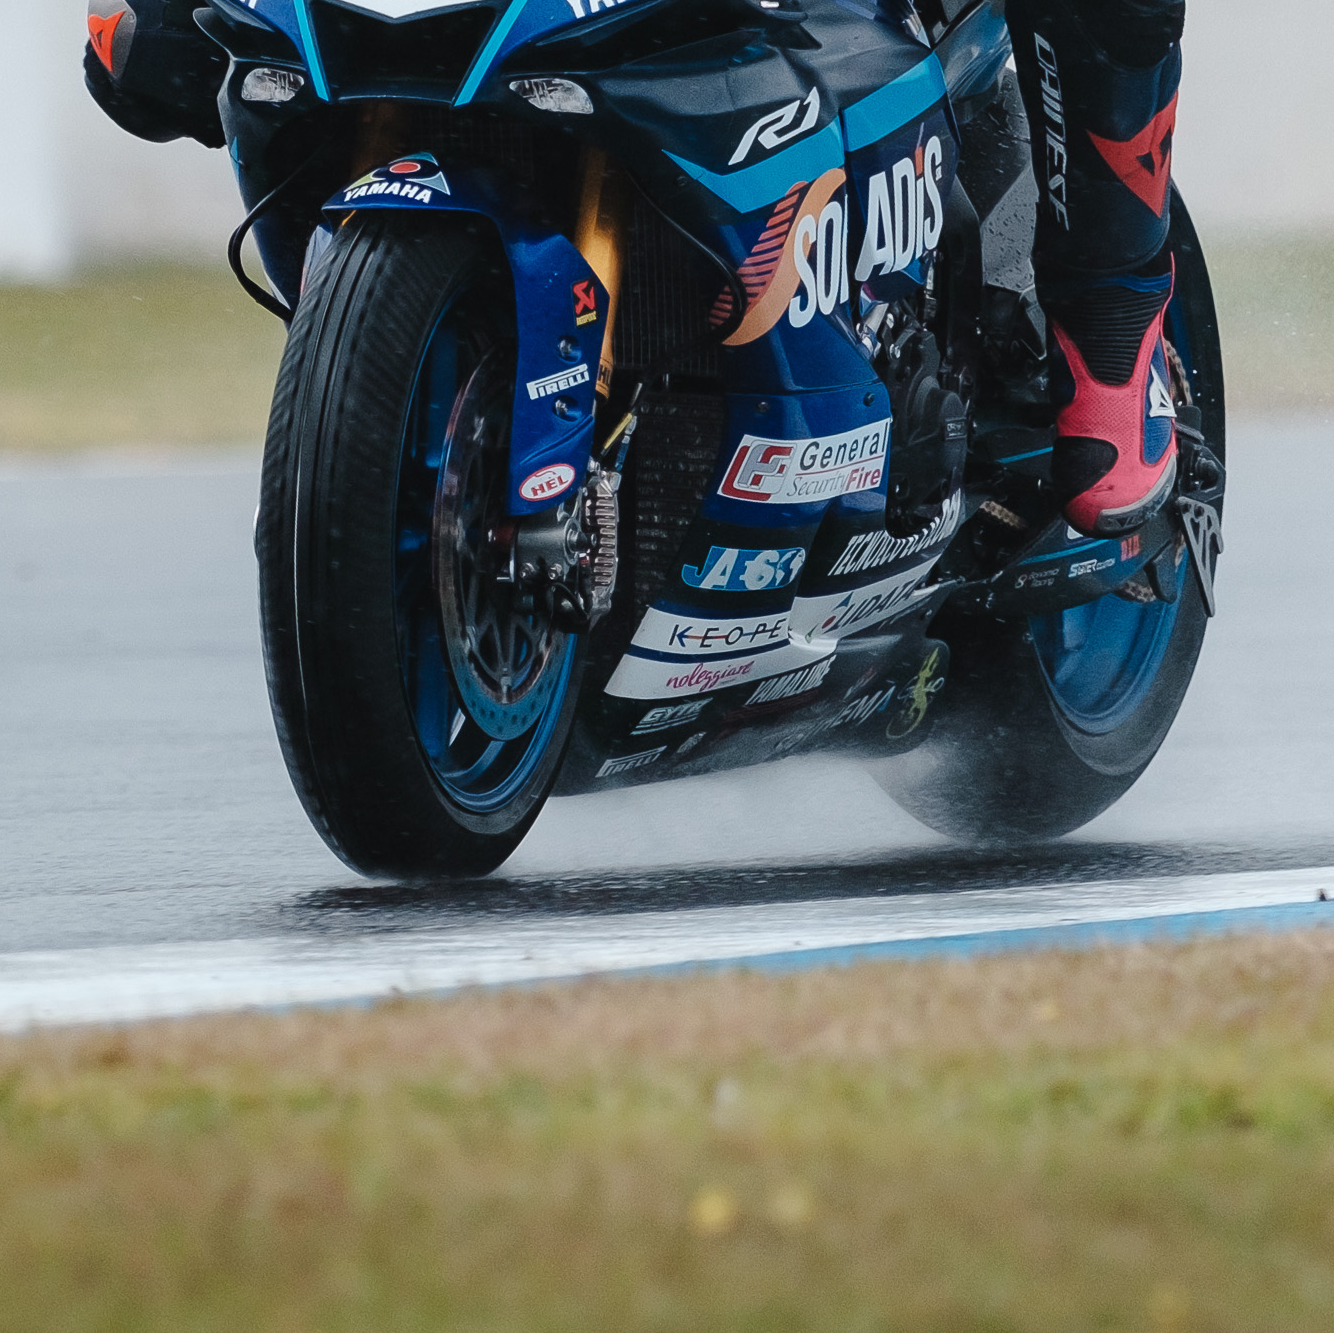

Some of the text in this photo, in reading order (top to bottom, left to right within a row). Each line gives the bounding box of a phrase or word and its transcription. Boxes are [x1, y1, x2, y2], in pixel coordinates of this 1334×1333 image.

[344, 181, 434, 205] YAMAHA
[526, 363, 590, 401] PIRELLI
[798, 421, 891, 472] General
[530, 474, 569, 498] HEL
